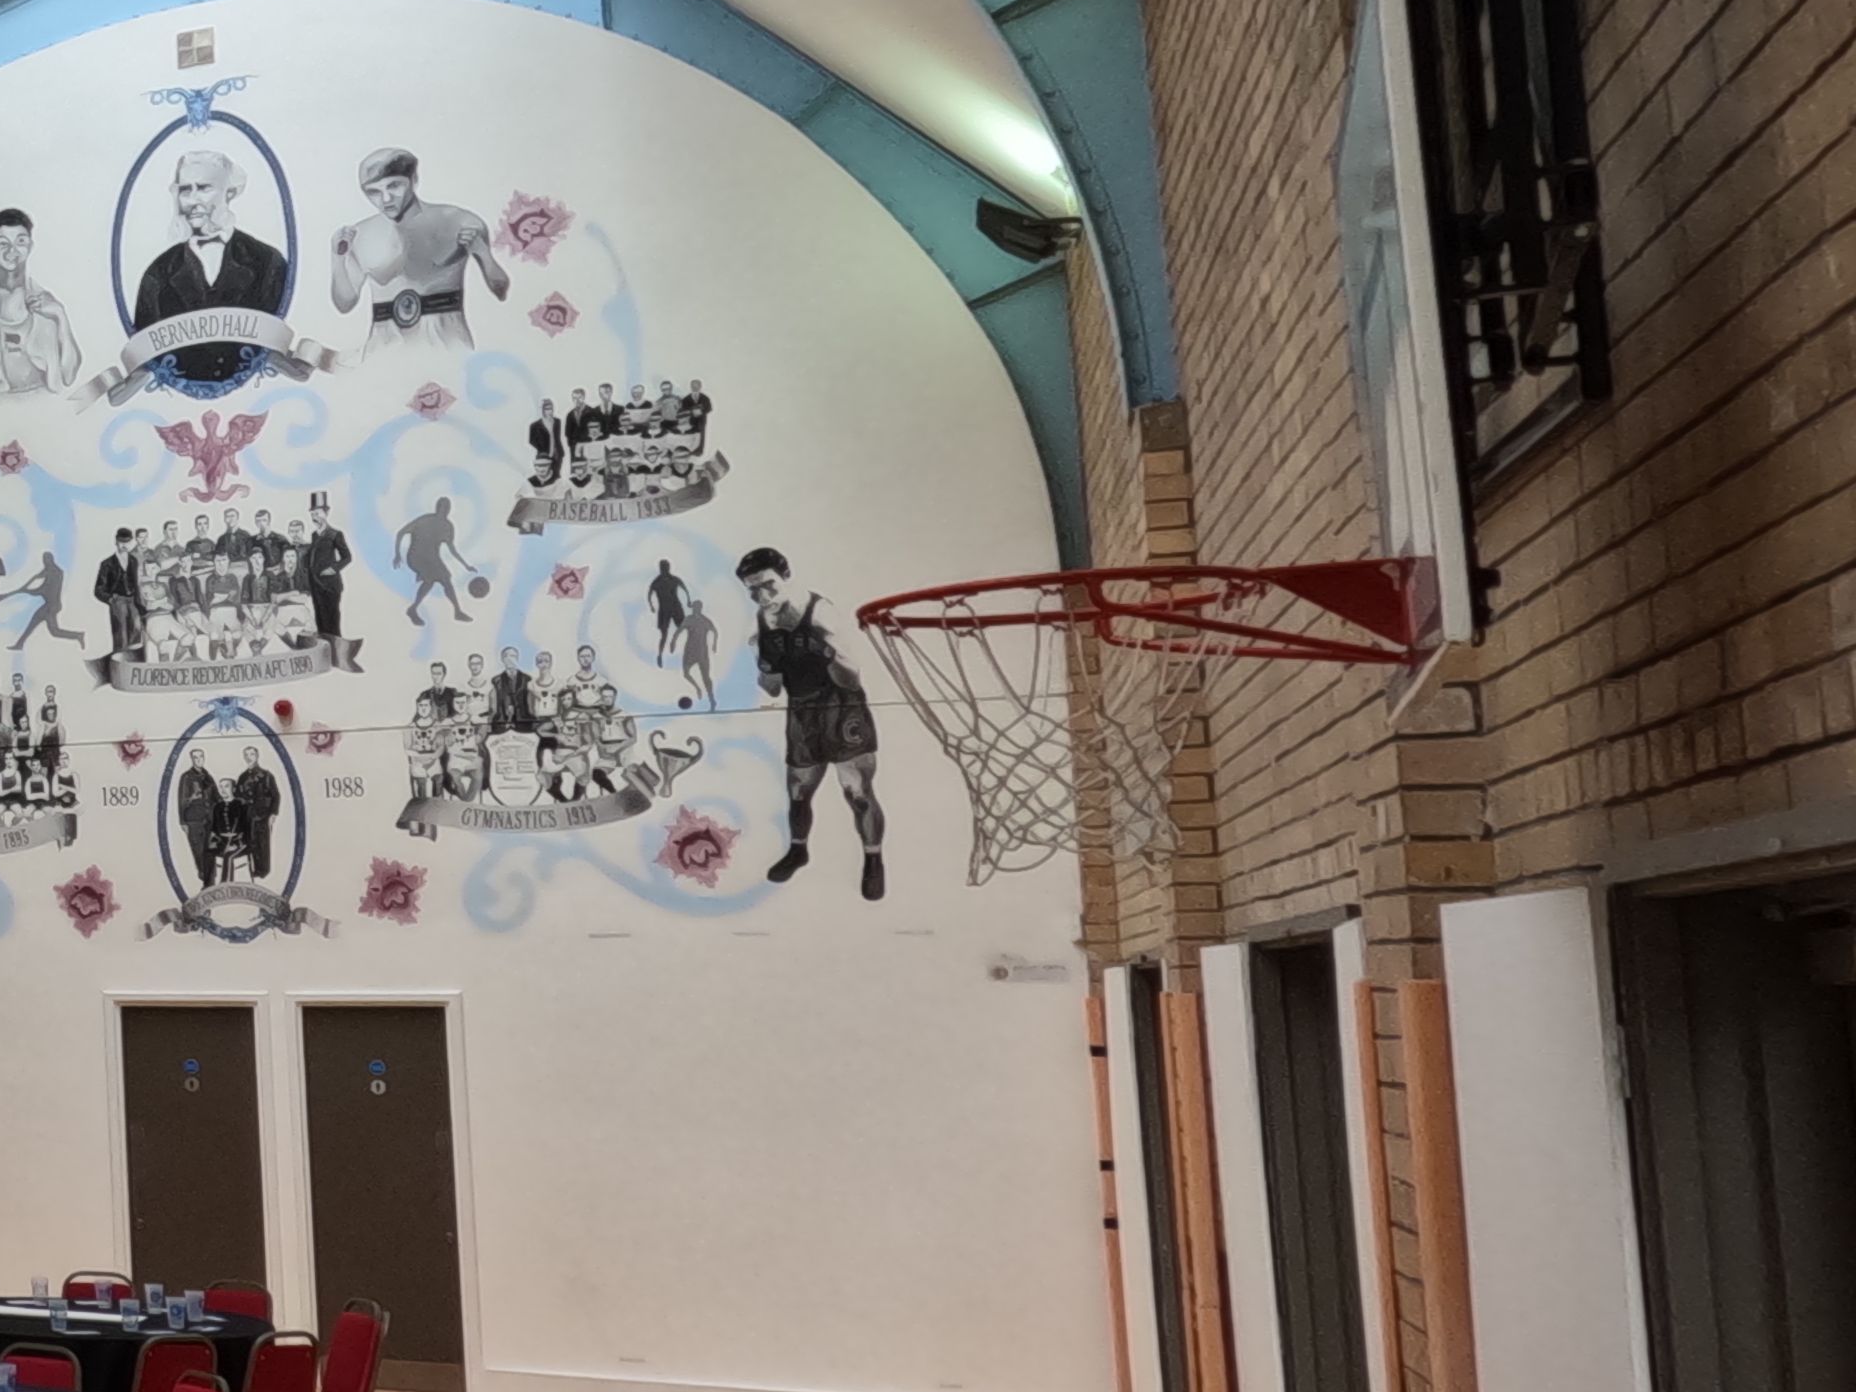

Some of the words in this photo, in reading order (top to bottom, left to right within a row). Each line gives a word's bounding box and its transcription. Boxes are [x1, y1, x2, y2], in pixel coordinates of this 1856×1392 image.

[148, 314, 220, 351] BERNARD
[221, 314, 259, 339] HALL
[548, 501, 628, 523] BASEBALL
[636, 496, 673, 519] 1933
[130, 666, 190, 687] FLORENCE
[192, 663, 263, 685] RECREATION
[264, 658, 288, 680] AFC
[289, 655, 313, 676] 1890
[101, 785, 140, 807] 1889
[324, 776, 365, 799] 1988
[460, 806, 558, 829] GYMNASTICS
